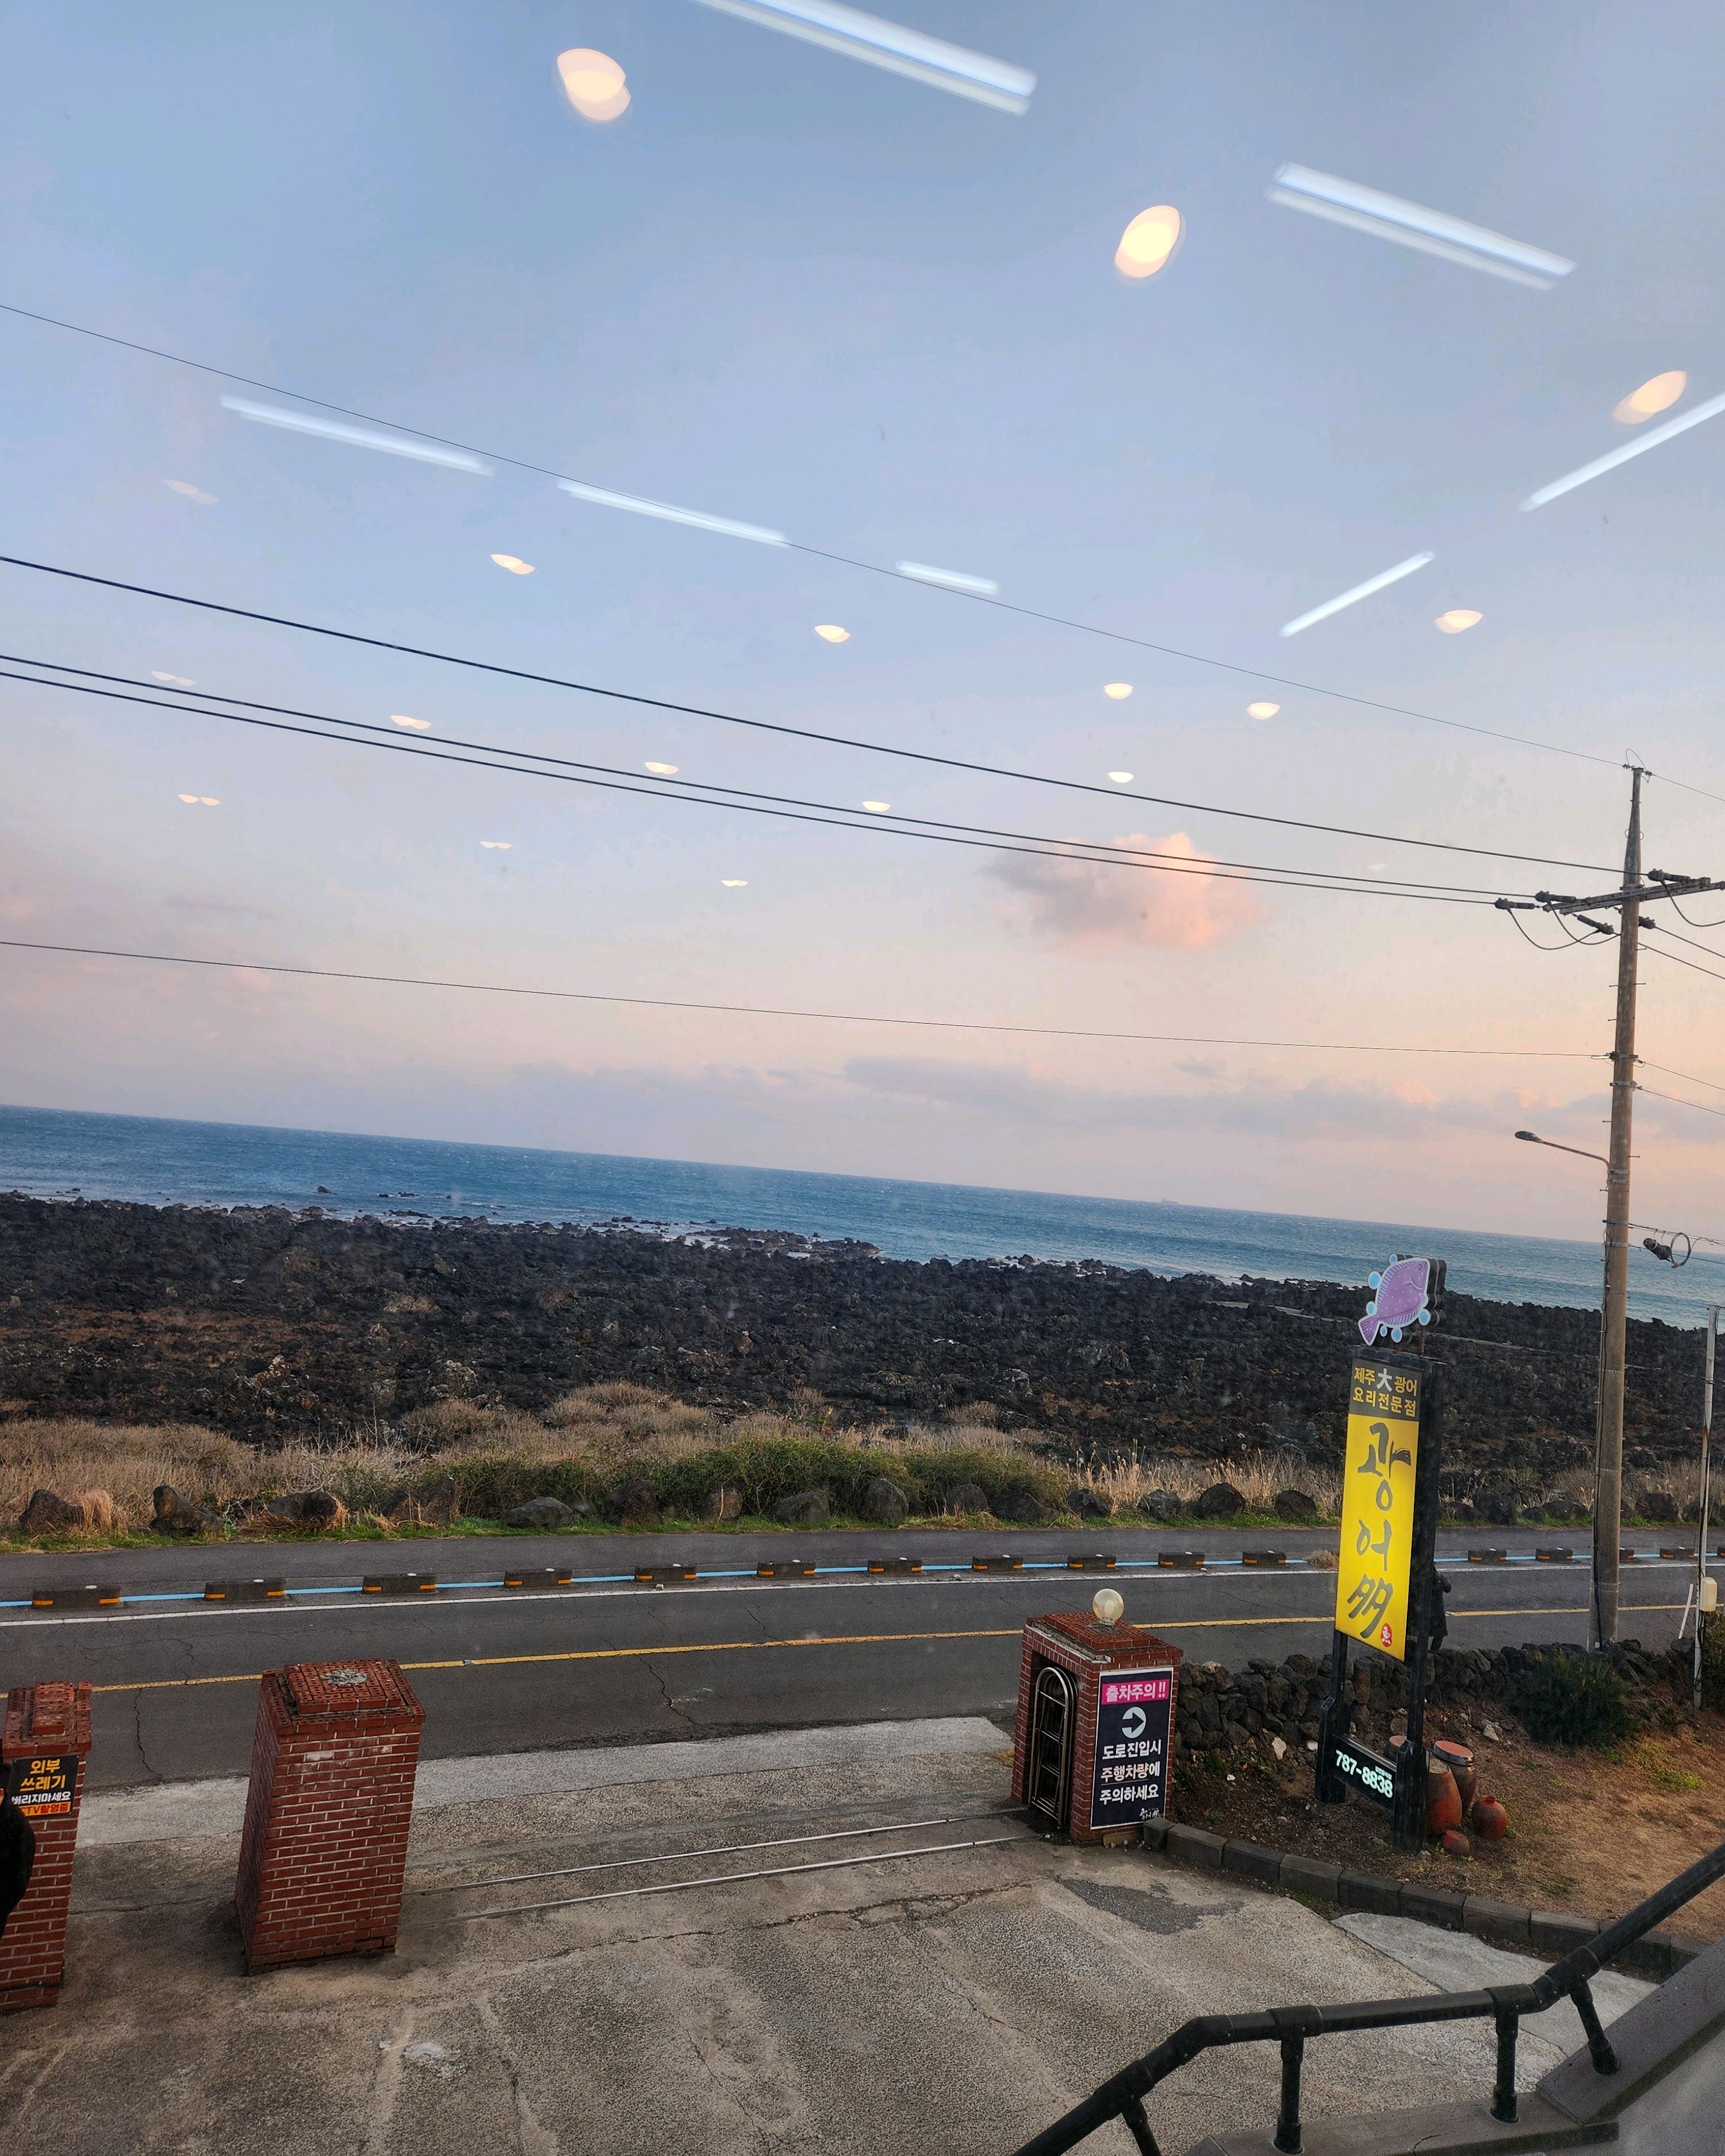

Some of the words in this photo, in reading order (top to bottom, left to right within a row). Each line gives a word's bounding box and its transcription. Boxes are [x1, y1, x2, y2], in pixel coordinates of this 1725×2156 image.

[1102, 1739, 1162, 1760] 도로진입시
[30, 1759, 60, 1774] 외부
[1101, 1761, 1160, 1782] 주행차량에
[1336, 1750, 1393, 1798] 787-8838
[20, 1775, 66, 1791] 쓰레기
[12, 1791, 71, 1805] 버리지마세요
[1099, 1784, 1159, 1805] 주의하세요
